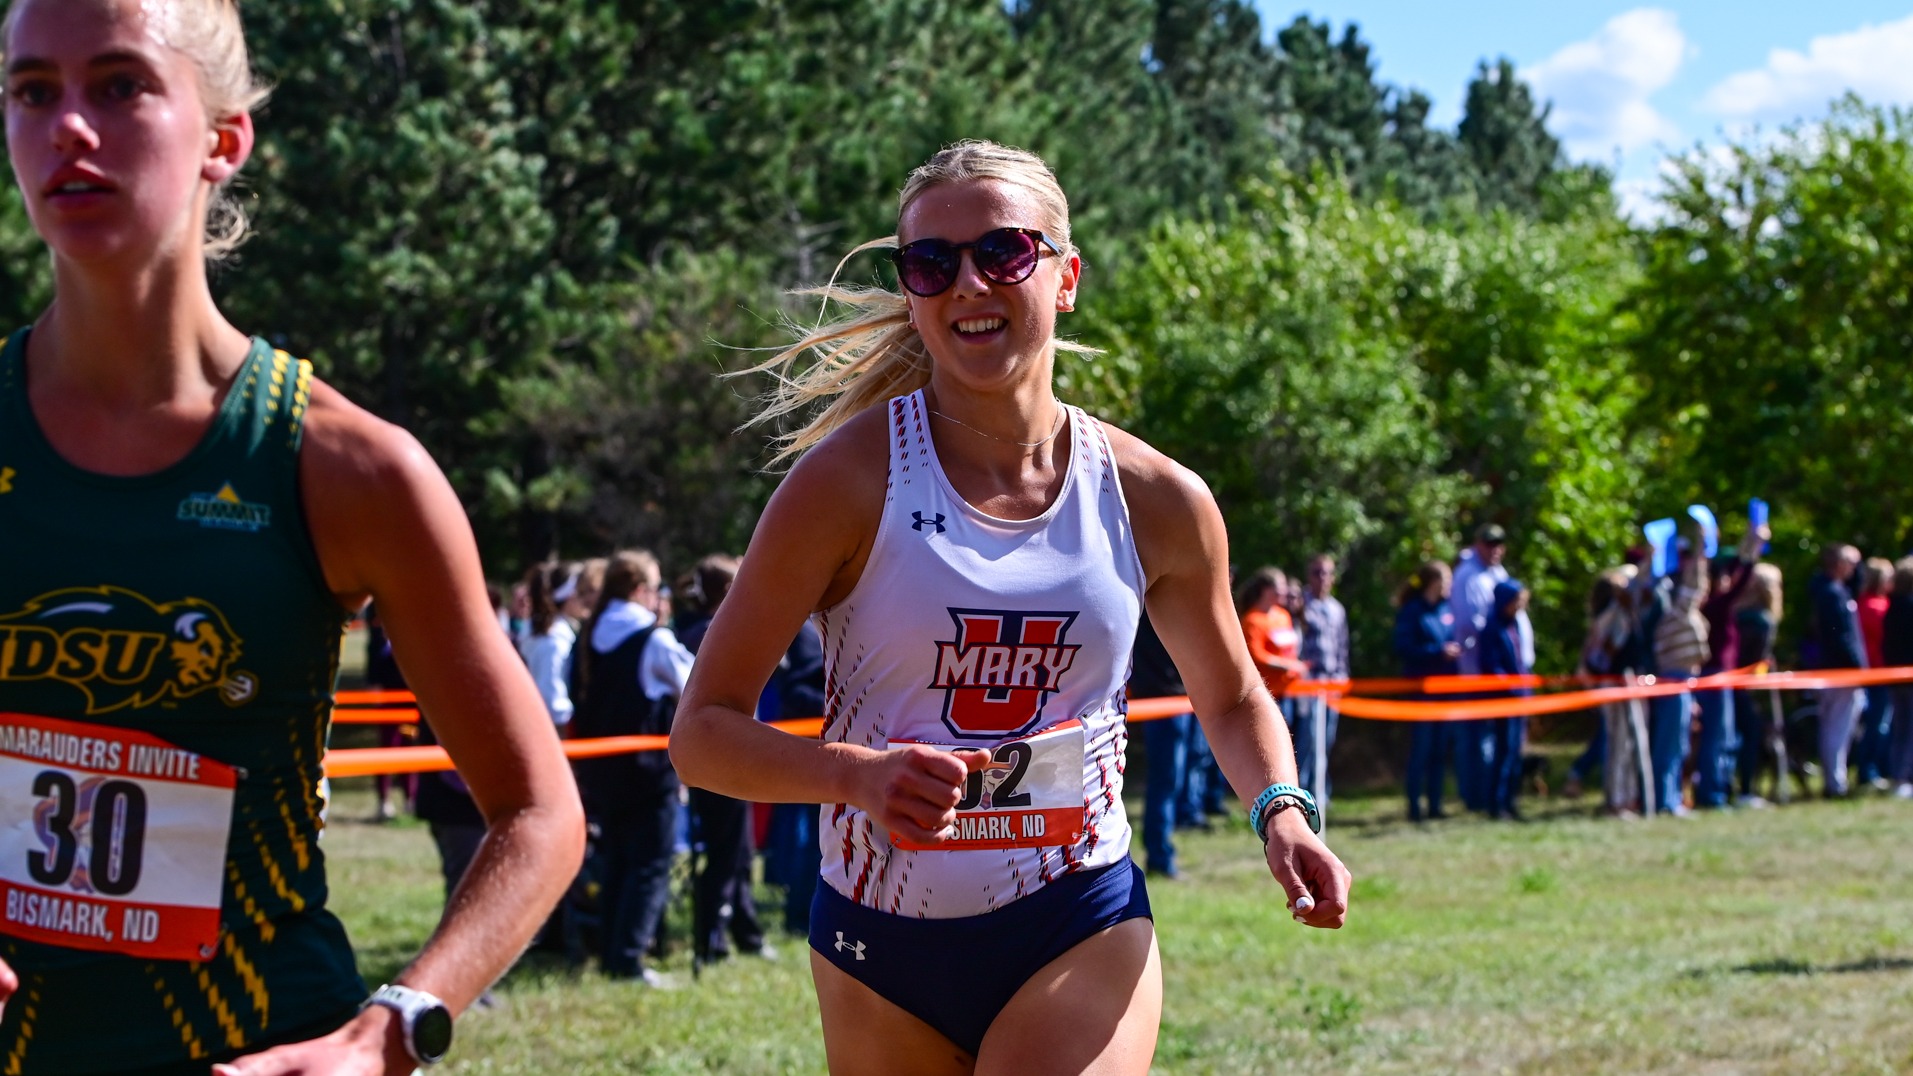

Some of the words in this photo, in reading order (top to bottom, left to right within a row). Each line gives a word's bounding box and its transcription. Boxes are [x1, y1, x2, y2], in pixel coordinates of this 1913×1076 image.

[0, 625, 166, 684] DSU
[929, 641, 1081, 693] MARY
[942, 607, 1080, 740] U
[0, 725, 123, 771] MARAUDERS
[128, 744, 201, 780] INVITE
[27, 770, 148, 896] 30
[949, 815, 1016, 841] SMARK,
[1022, 814, 1045, 838] ND
[6, 888, 113, 942] BISMARK,
[122, 908, 159, 943] ND
